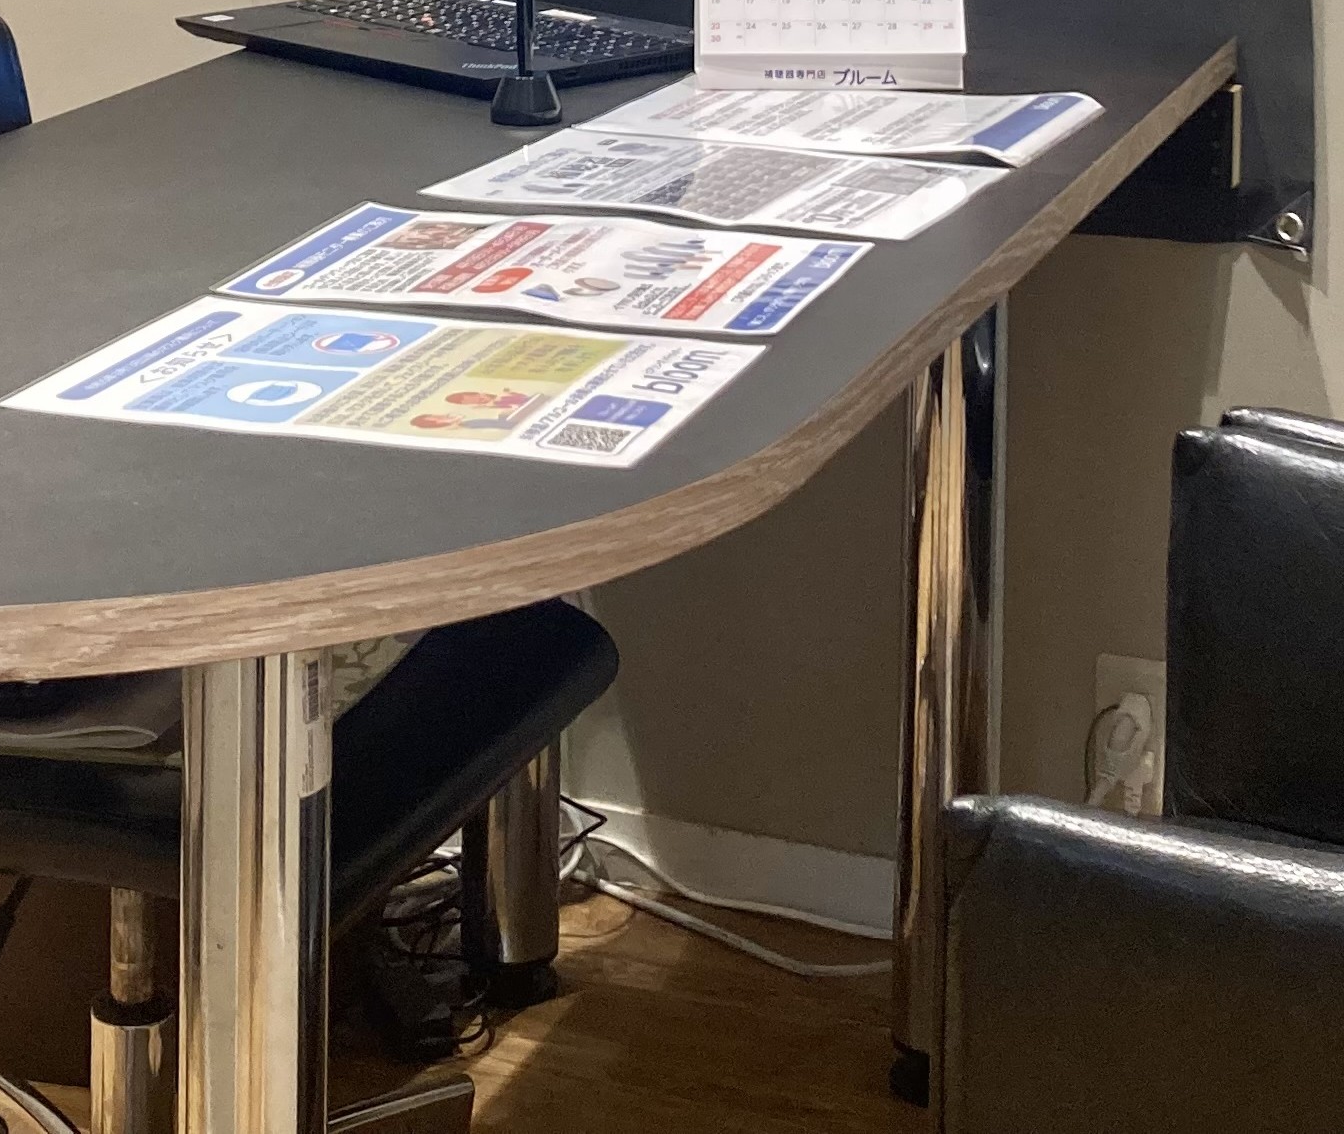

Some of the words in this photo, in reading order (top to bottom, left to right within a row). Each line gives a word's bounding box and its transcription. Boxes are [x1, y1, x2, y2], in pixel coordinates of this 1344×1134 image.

[833, 68, 897, 86] ブルーム
[632, 350, 729, 395] bloom
